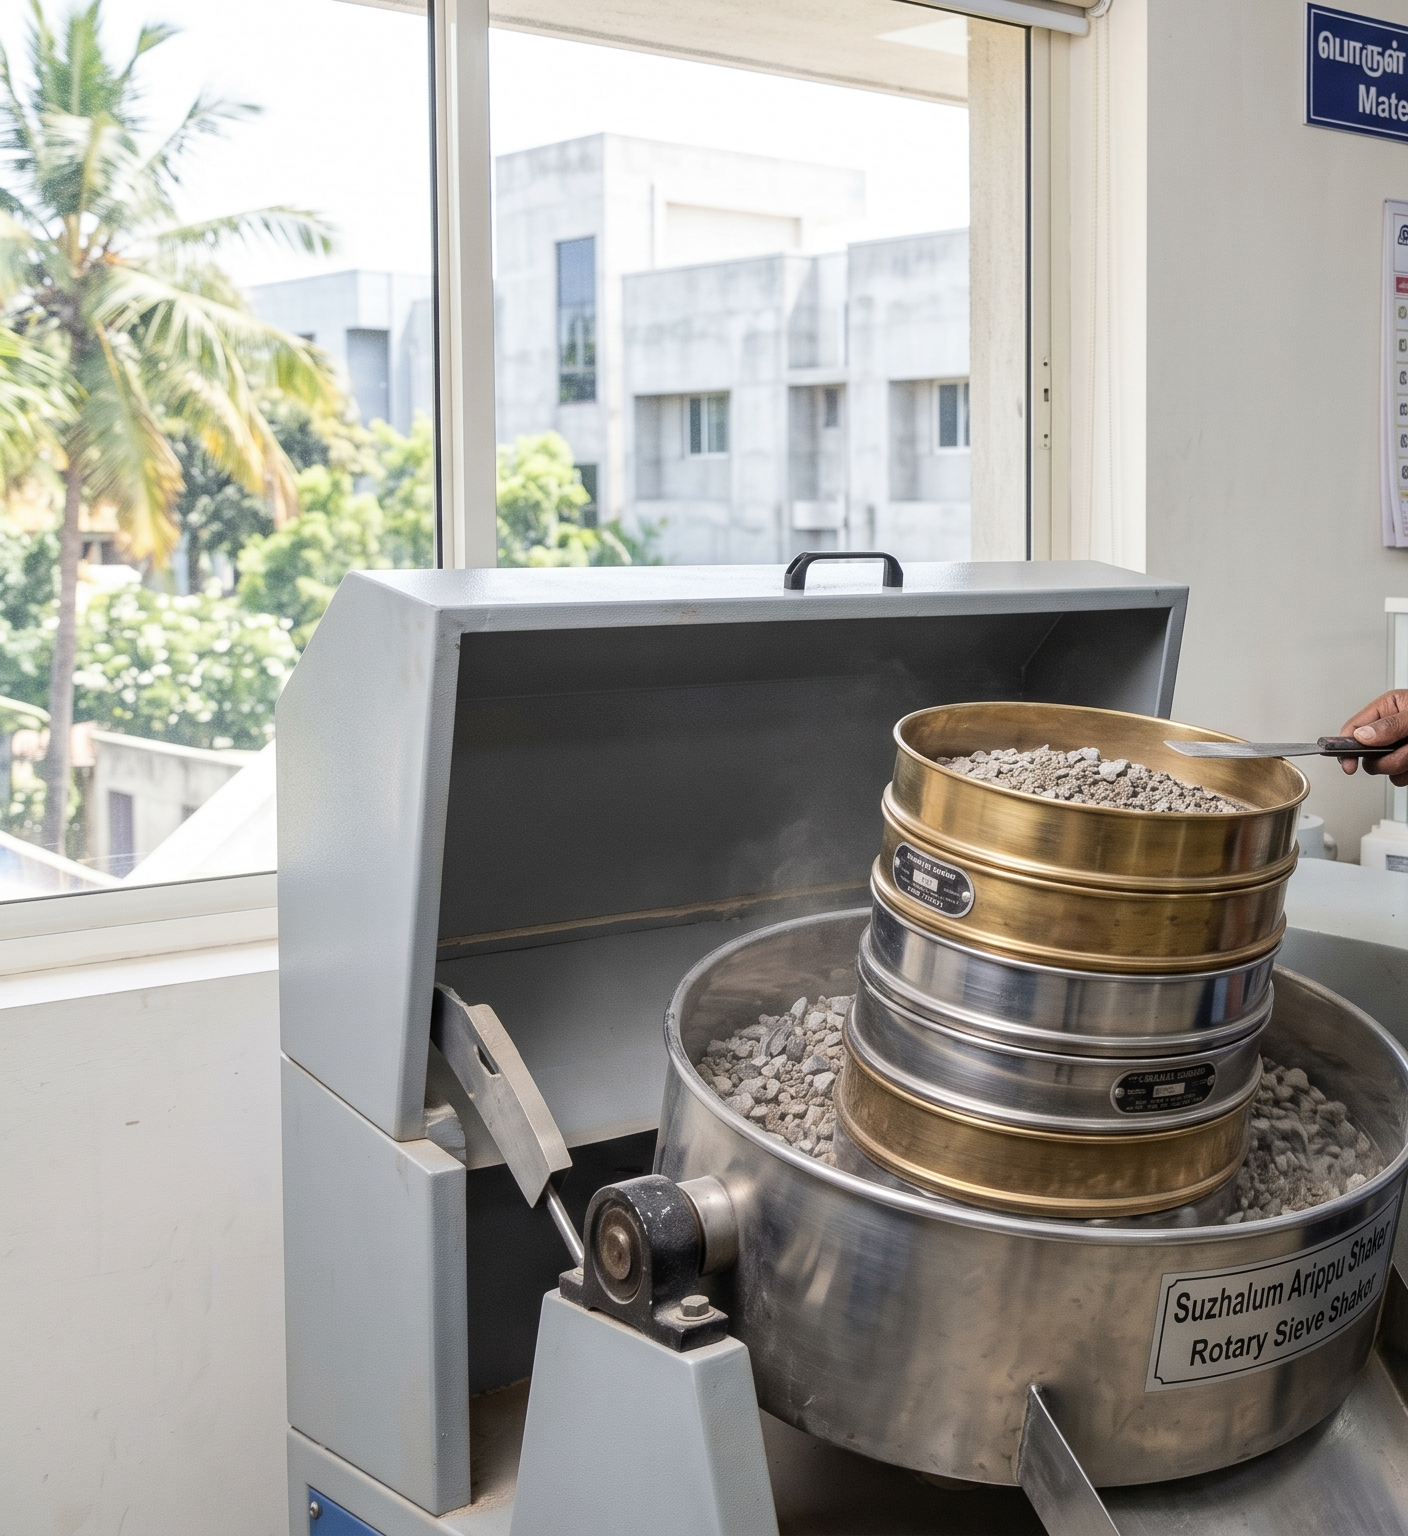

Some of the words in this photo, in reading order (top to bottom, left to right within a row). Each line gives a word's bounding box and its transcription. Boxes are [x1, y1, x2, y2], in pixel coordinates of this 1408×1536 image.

[1318, 31, 1405, 77] பொருள்
[1174, 1281, 1284, 1323] Suzhalum
[1287, 1256, 1345, 1301] Arippu
[1348, 1221, 1390, 1272] Shaker
[1190, 1332, 1268, 1366] Rotary
[1274, 1310, 1324, 1347] Sieve
